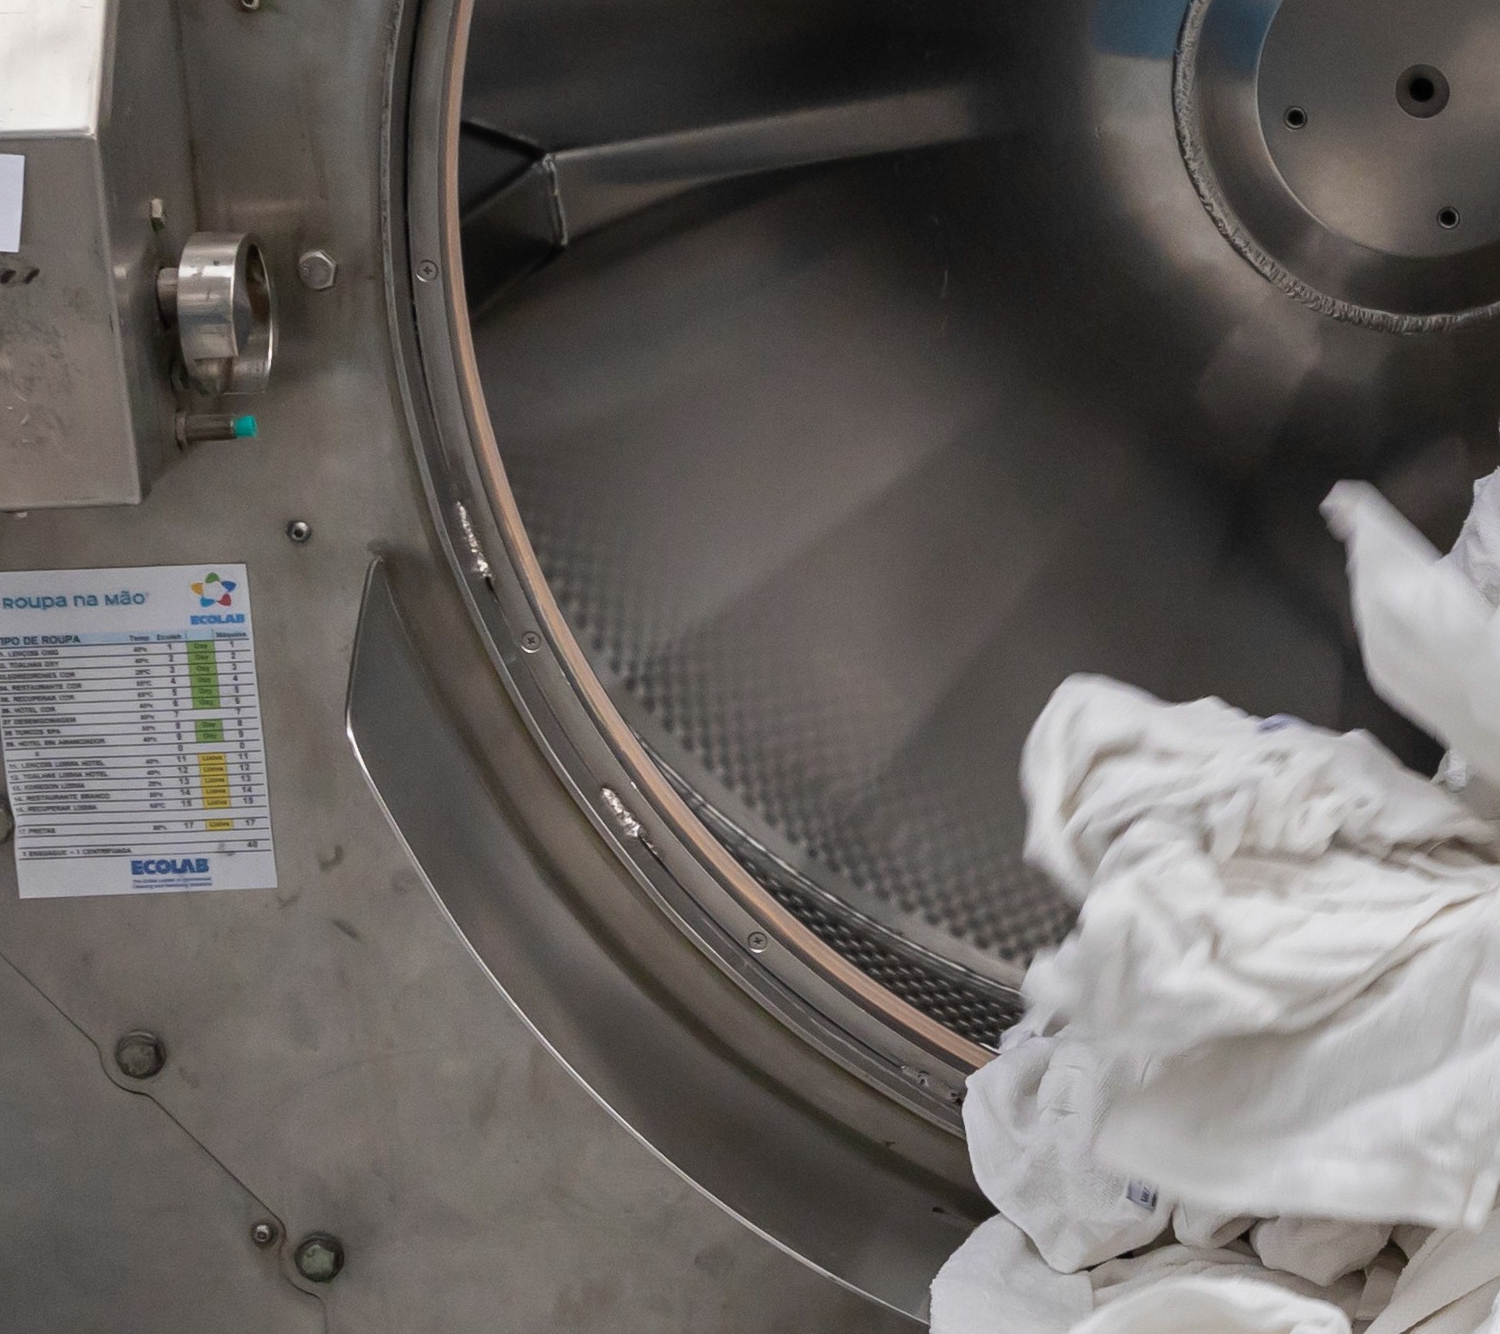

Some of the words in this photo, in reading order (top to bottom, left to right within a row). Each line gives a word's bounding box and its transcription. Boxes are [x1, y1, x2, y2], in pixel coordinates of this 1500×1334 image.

[2, 593, 67, 610] Roupa
[73, 595, 98, 607] na
[105, 590, 146, 606] Mão
[190, 614, 245, 625] ECOLAB
[23, 636, 38, 645] DE
[42, 635, 81, 644] ROUPA
[131, 859, 210, 875] ECOLAB
